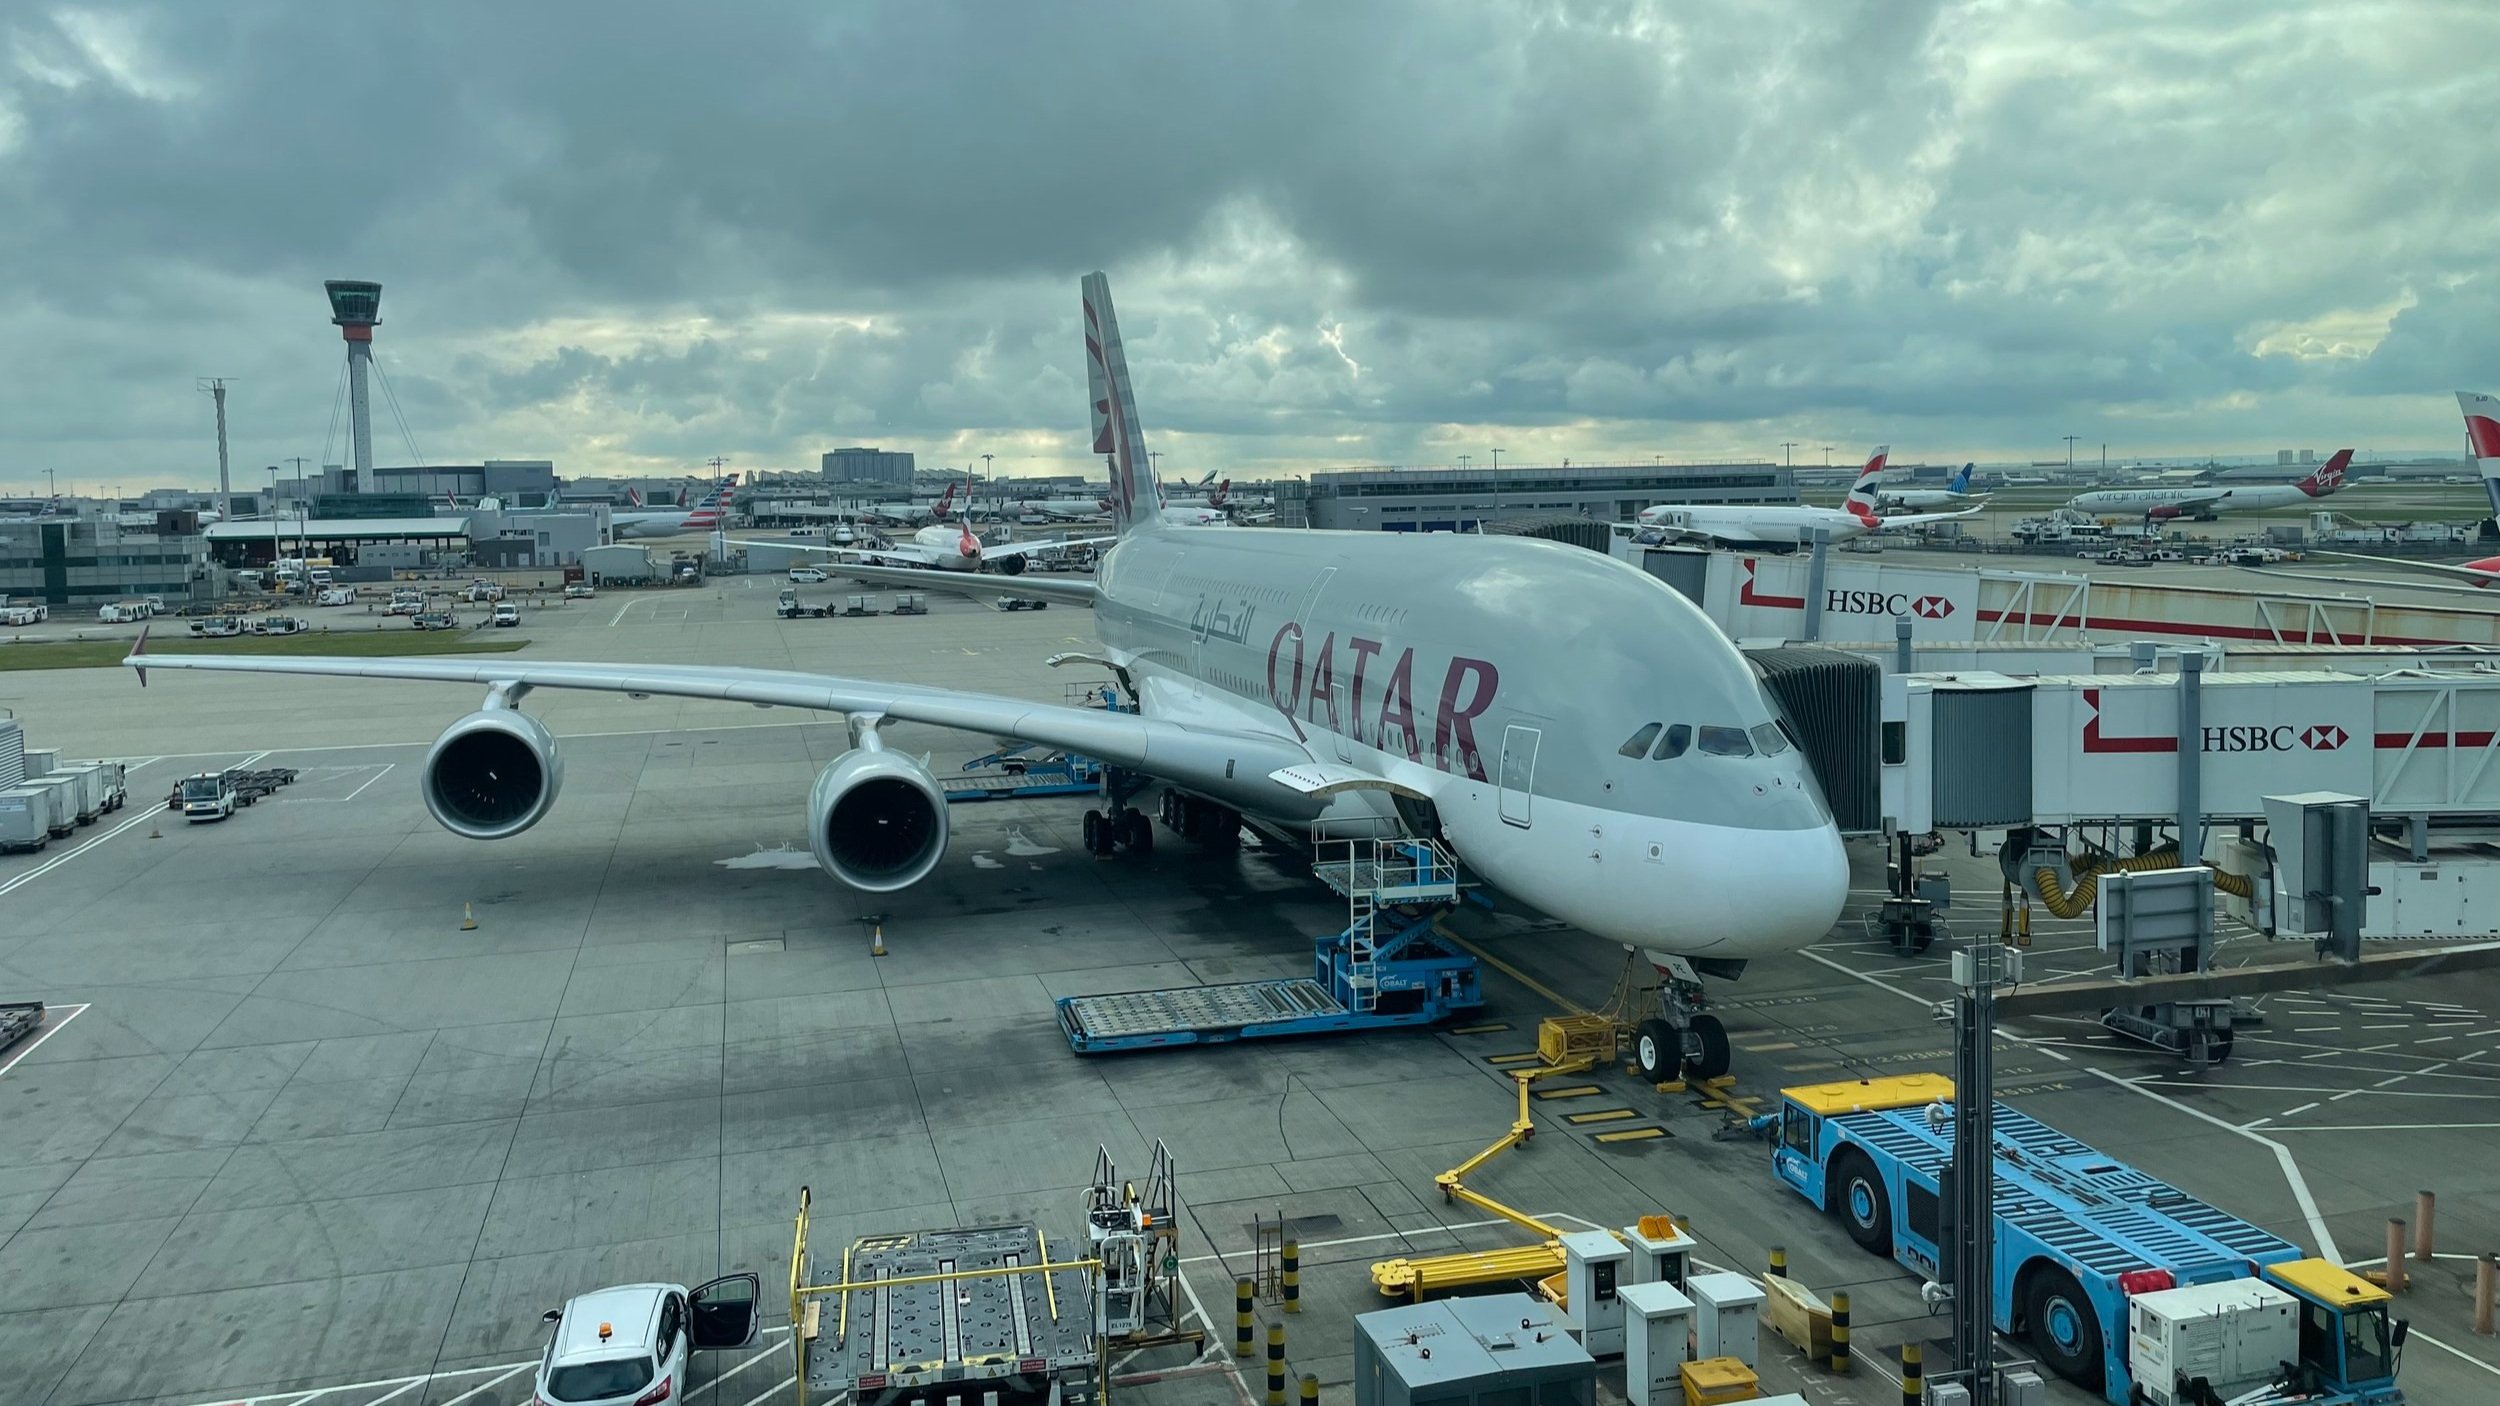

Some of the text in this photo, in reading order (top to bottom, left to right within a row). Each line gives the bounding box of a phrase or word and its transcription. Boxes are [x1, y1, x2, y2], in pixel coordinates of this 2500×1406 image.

[2313, 465, 2343, 487] Virgin
[1825, 589, 1907, 616] HSBC
[1190, 592, 1256, 646] القطرية
[1267, 622, 1499, 784] QATAR
[2200, 725, 2294, 752] HSBC
